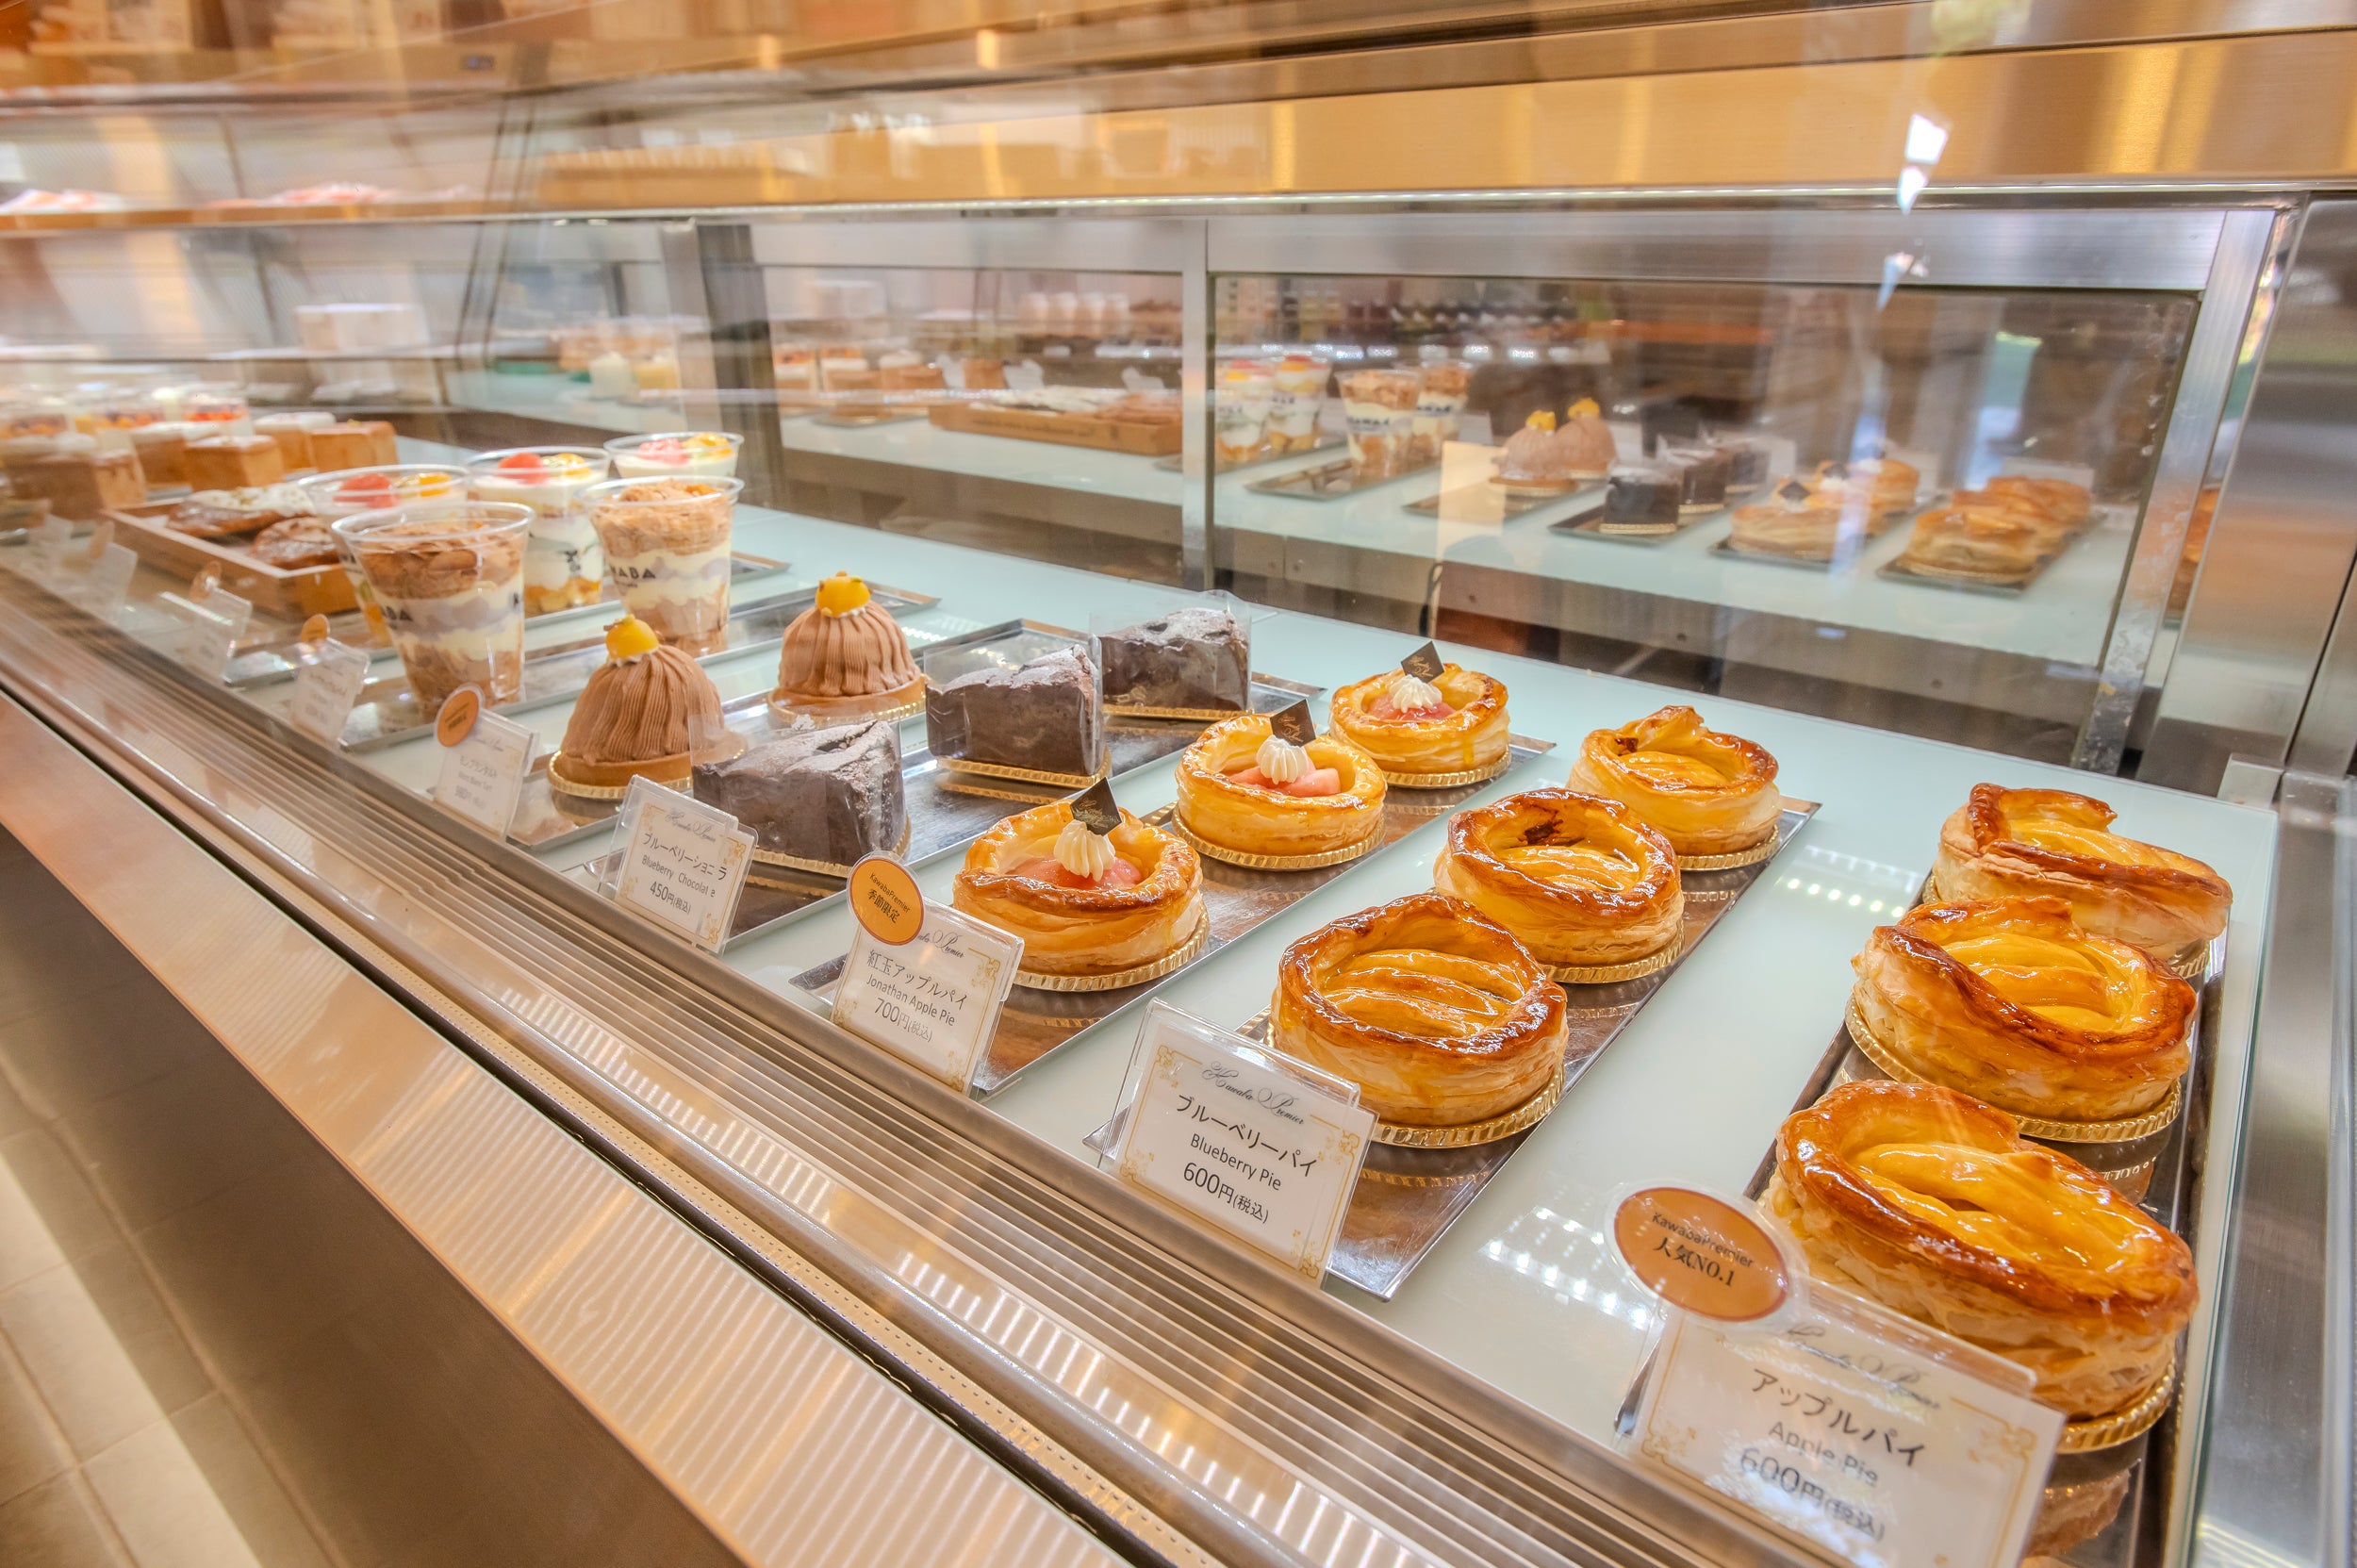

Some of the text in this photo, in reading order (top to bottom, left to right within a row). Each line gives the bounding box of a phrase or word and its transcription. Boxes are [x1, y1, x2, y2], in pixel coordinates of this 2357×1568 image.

[642, 854, 675, 880] Blueberry
[868, 888, 900, 923] 季節限定
[866, 949, 967, 1010] 紅玉アップルパイ
[866, 974, 955, 1027] Jonathan Apple Pie
[875, 998, 933, 1043] 700円(税込)
[1257, 1087, 1305, 1125] Premier
[1176, 1094, 1319, 1178] ブルーベリーパイ
[1190, 1132, 1282, 1191] Blueberry Pie
[1183, 1162, 1269, 1224] 600円(税込)
[1652, 1212, 1755, 1268] KawabaPremier
[1752, 1368, 1925, 1467] アップルパイ
[1769, 1421, 1879, 1487] Apple Pie
